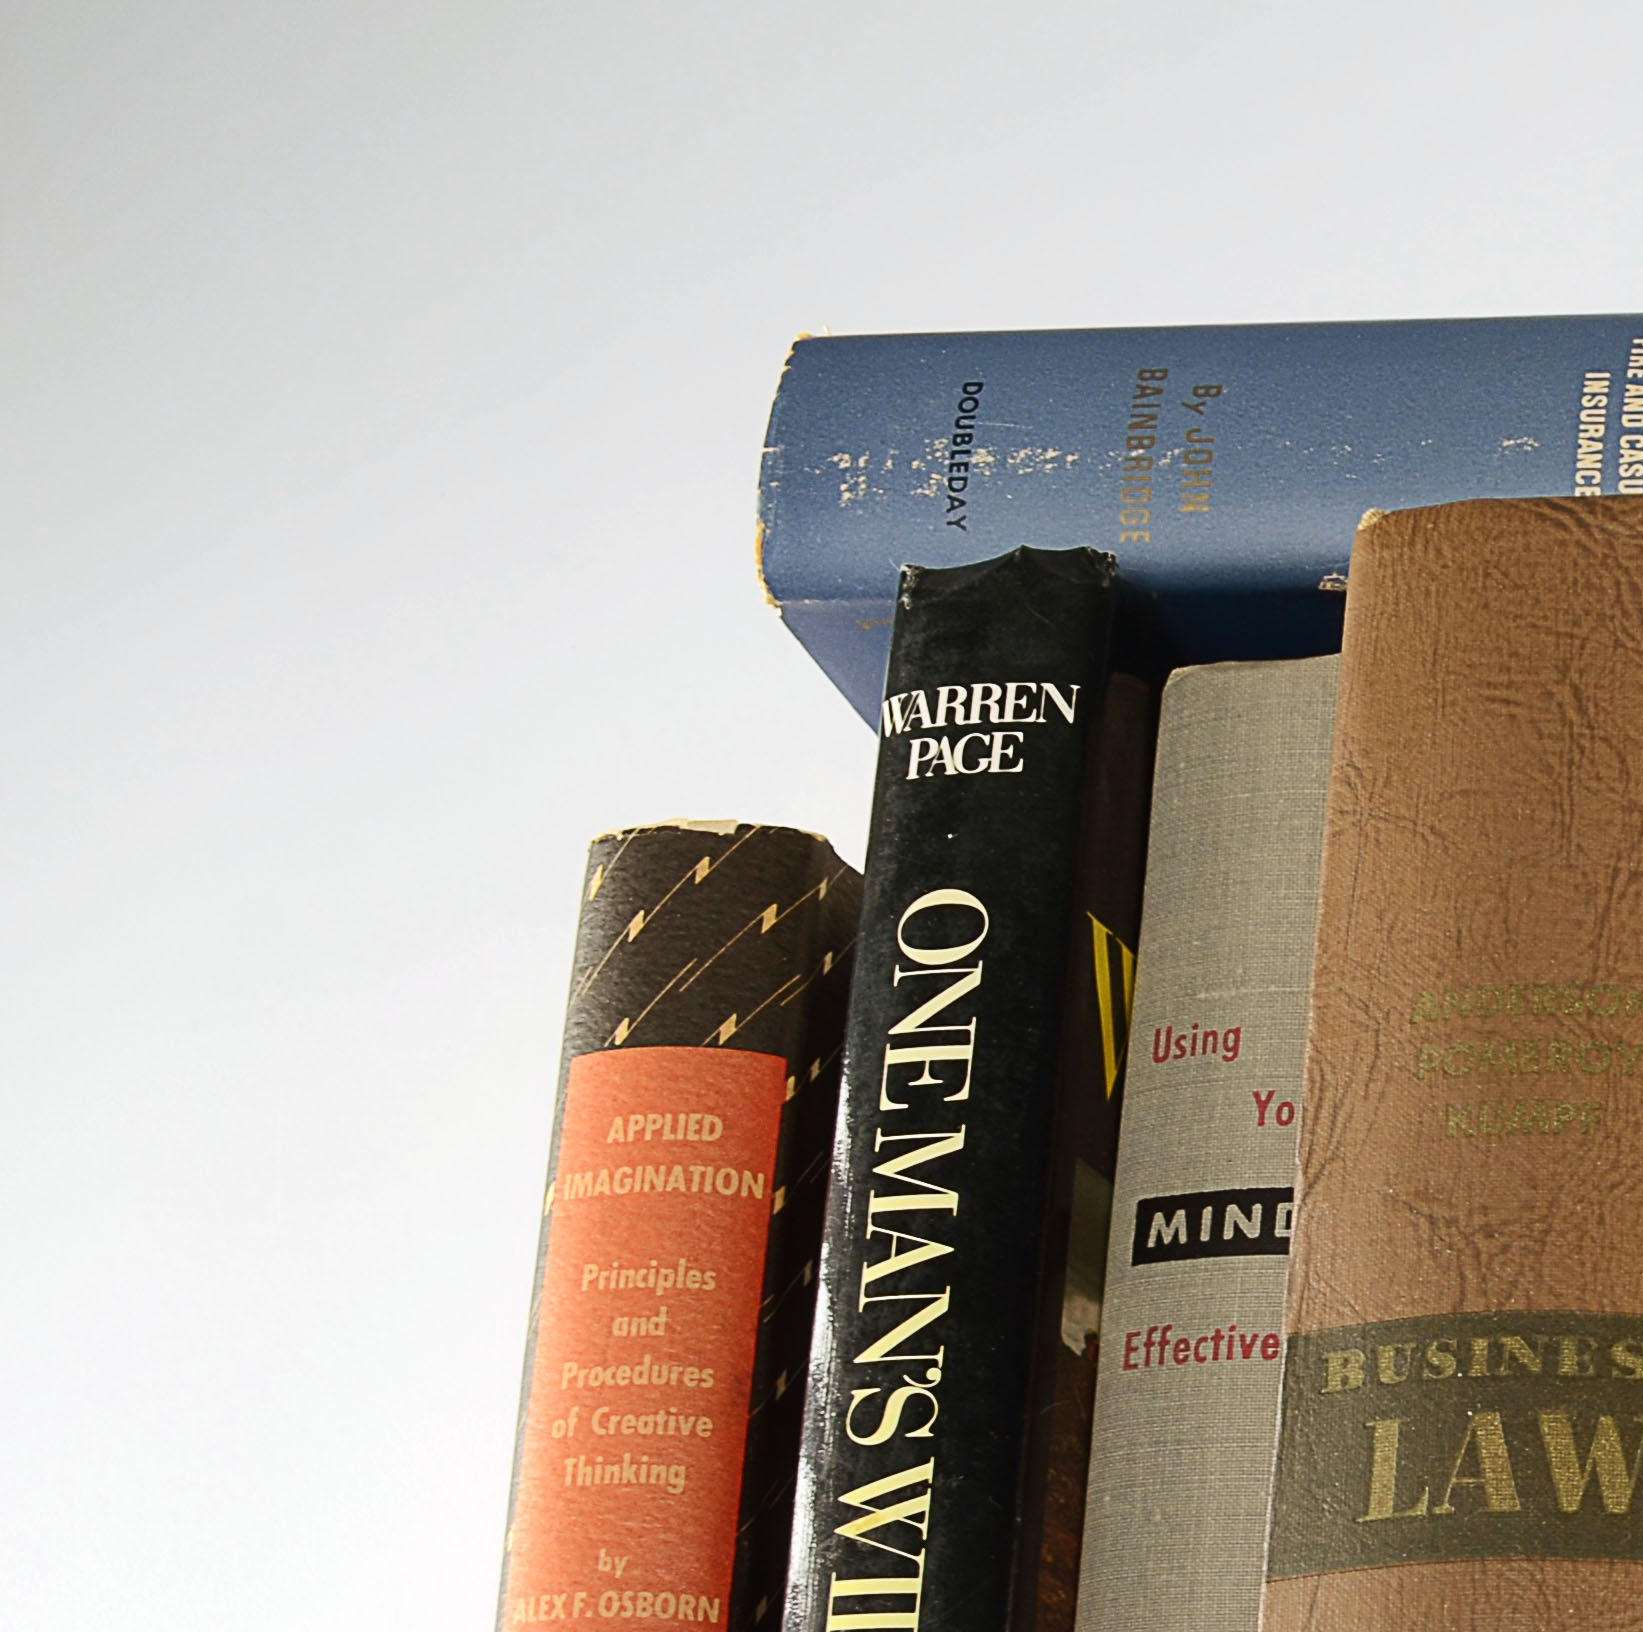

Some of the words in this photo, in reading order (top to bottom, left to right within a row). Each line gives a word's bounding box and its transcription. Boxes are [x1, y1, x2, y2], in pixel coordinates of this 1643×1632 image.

[1182, 383, 1223, 416] By
[1573, 370, 1612, 497] INSURANCE
[946, 381, 985, 532] DOUBLEDAY
[1118, 366, 1170, 545] BAINBRIDGE
[1179, 427, 1215, 514] JOHN
[880, 681, 1081, 738] WARREN
[906, 731, 1026, 781] PAGE
[879, 888, 990, 1112] ONE
[1150, 1022, 1242, 1064] Using
[606, 1112, 724, 1145] APPLIED
[1252, 1089, 1296, 1128] Yo
[1445, 1100, 1603, 1138] KUMPF
[562, 1164, 766, 1201] IMAGINATION
[580, 1257, 717, 1296] Principles
[844, 1124, 967, 1448] MAN'S
[611, 1305, 668, 1337] and
[1121, 1323, 1281, 1372] Effective
[560, 1354, 715, 1390] Procedures
[551, 1406, 579, 1439] of
[590, 1406, 714, 1438] Creative
[563, 1452, 687, 1495] Thinking
[597, 1547, 629, 1580] by
[512, 1592, 568, 1625] ALEX
[571, 1591, 593, 1619] F.
[597, 1590, 721, 1624] OSBORN
